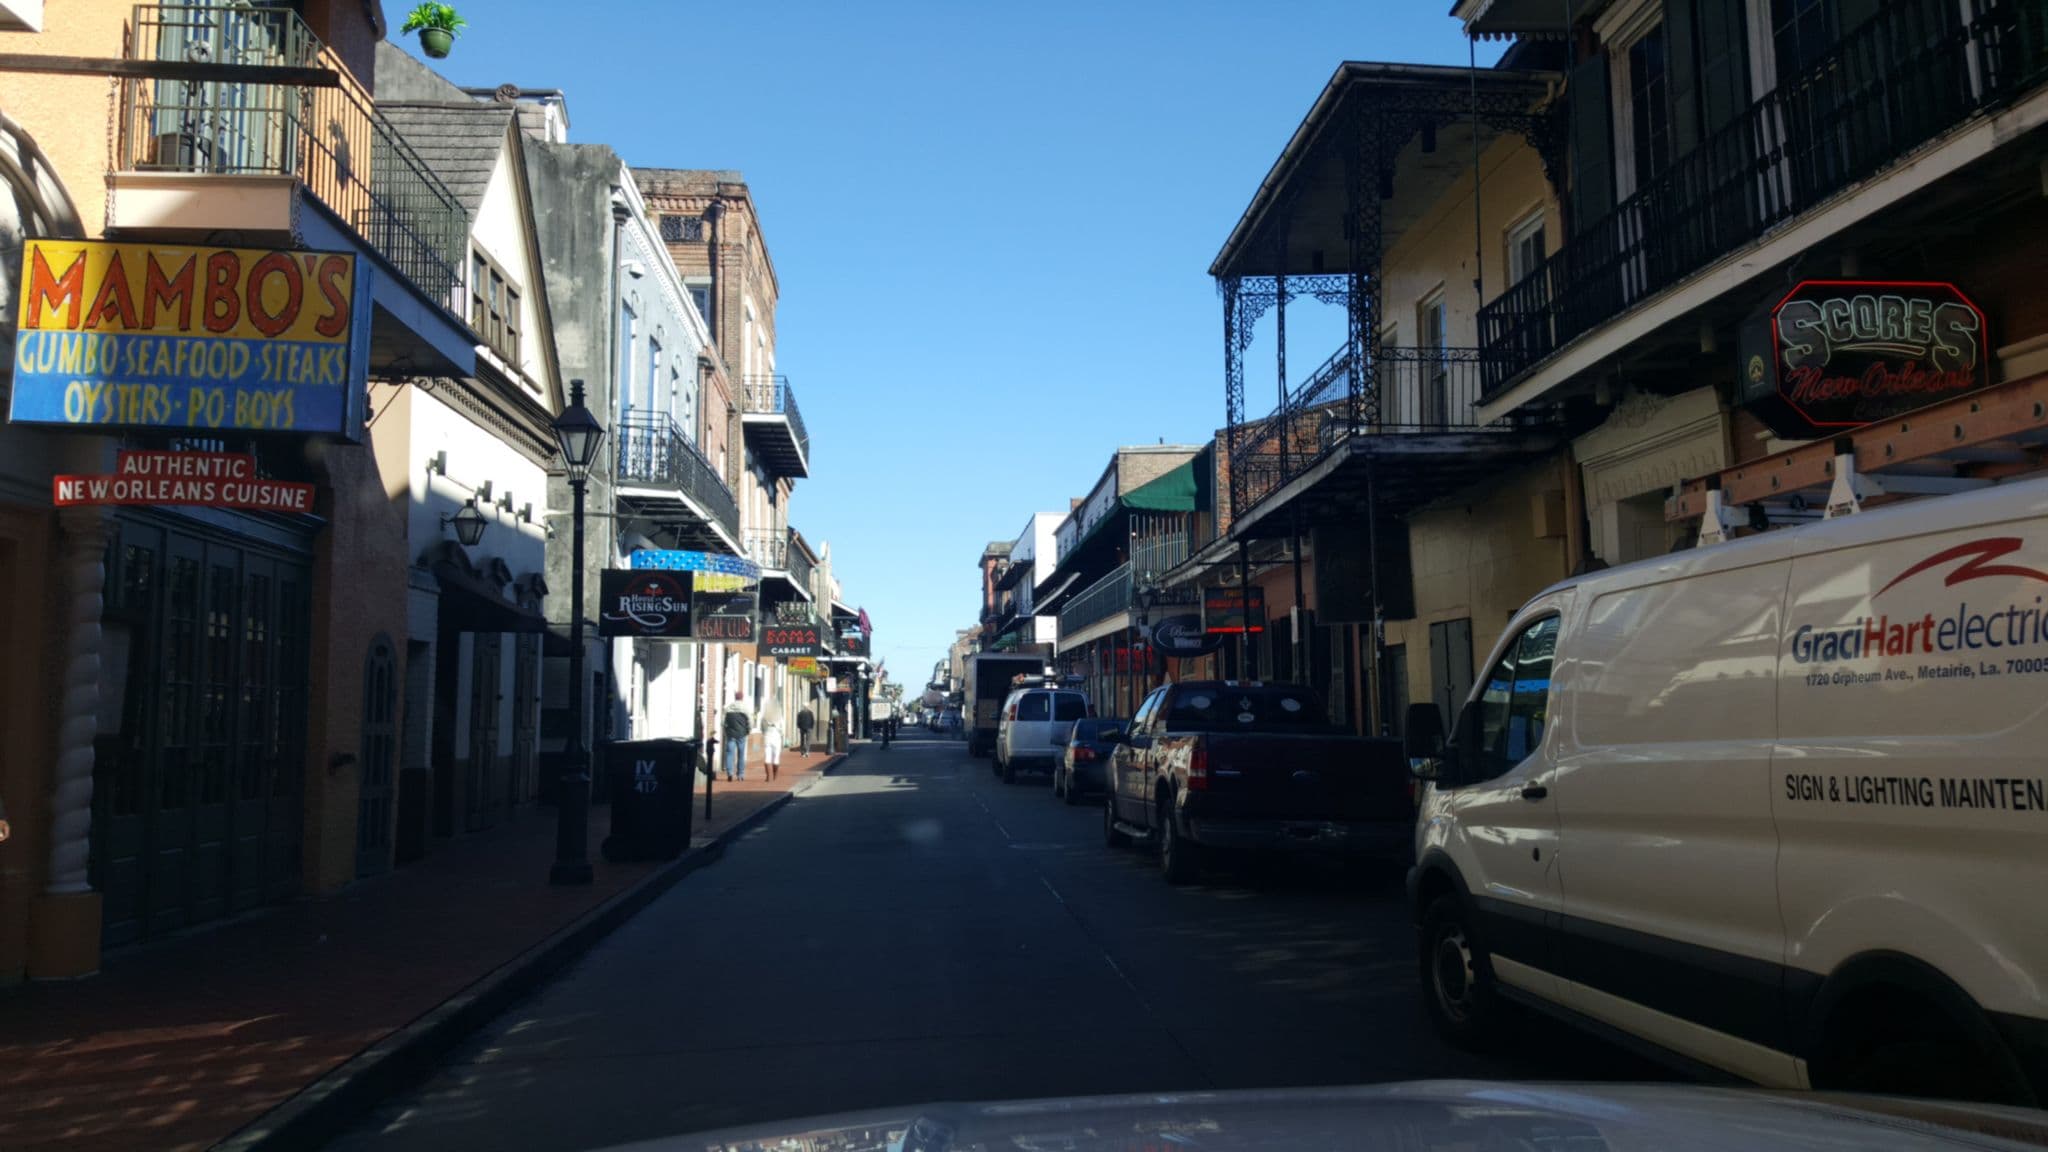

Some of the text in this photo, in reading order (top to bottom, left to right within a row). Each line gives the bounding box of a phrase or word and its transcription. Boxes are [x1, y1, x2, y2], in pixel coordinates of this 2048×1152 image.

[25, 243, 350, 338] MAMBO'S
[1777, 294, 1980, 373] SCORES
[261, 344, 347, 385] STEAKS
[1788, 360, 1977, 403] New Orleans
[64, 381, 173, 425] OYSTERS
[123, 454, 248, 478] AUTHENTIC
[58, 479, 308, 509] NEW ORLEANS CUISINE
[770, 646, 811, 655] CABARET
[1806, 673, 1830, 687] 1720
[1832, 671, 1882, 688] Orpheum
[1917, 663, 1976, 681] Metairie,
[1980, 661, 2001, 677] La.
[635, 759, 657, 775] IV
[1786, 774, 2048, 811] SIGN & LIGHTING MAINTEN
